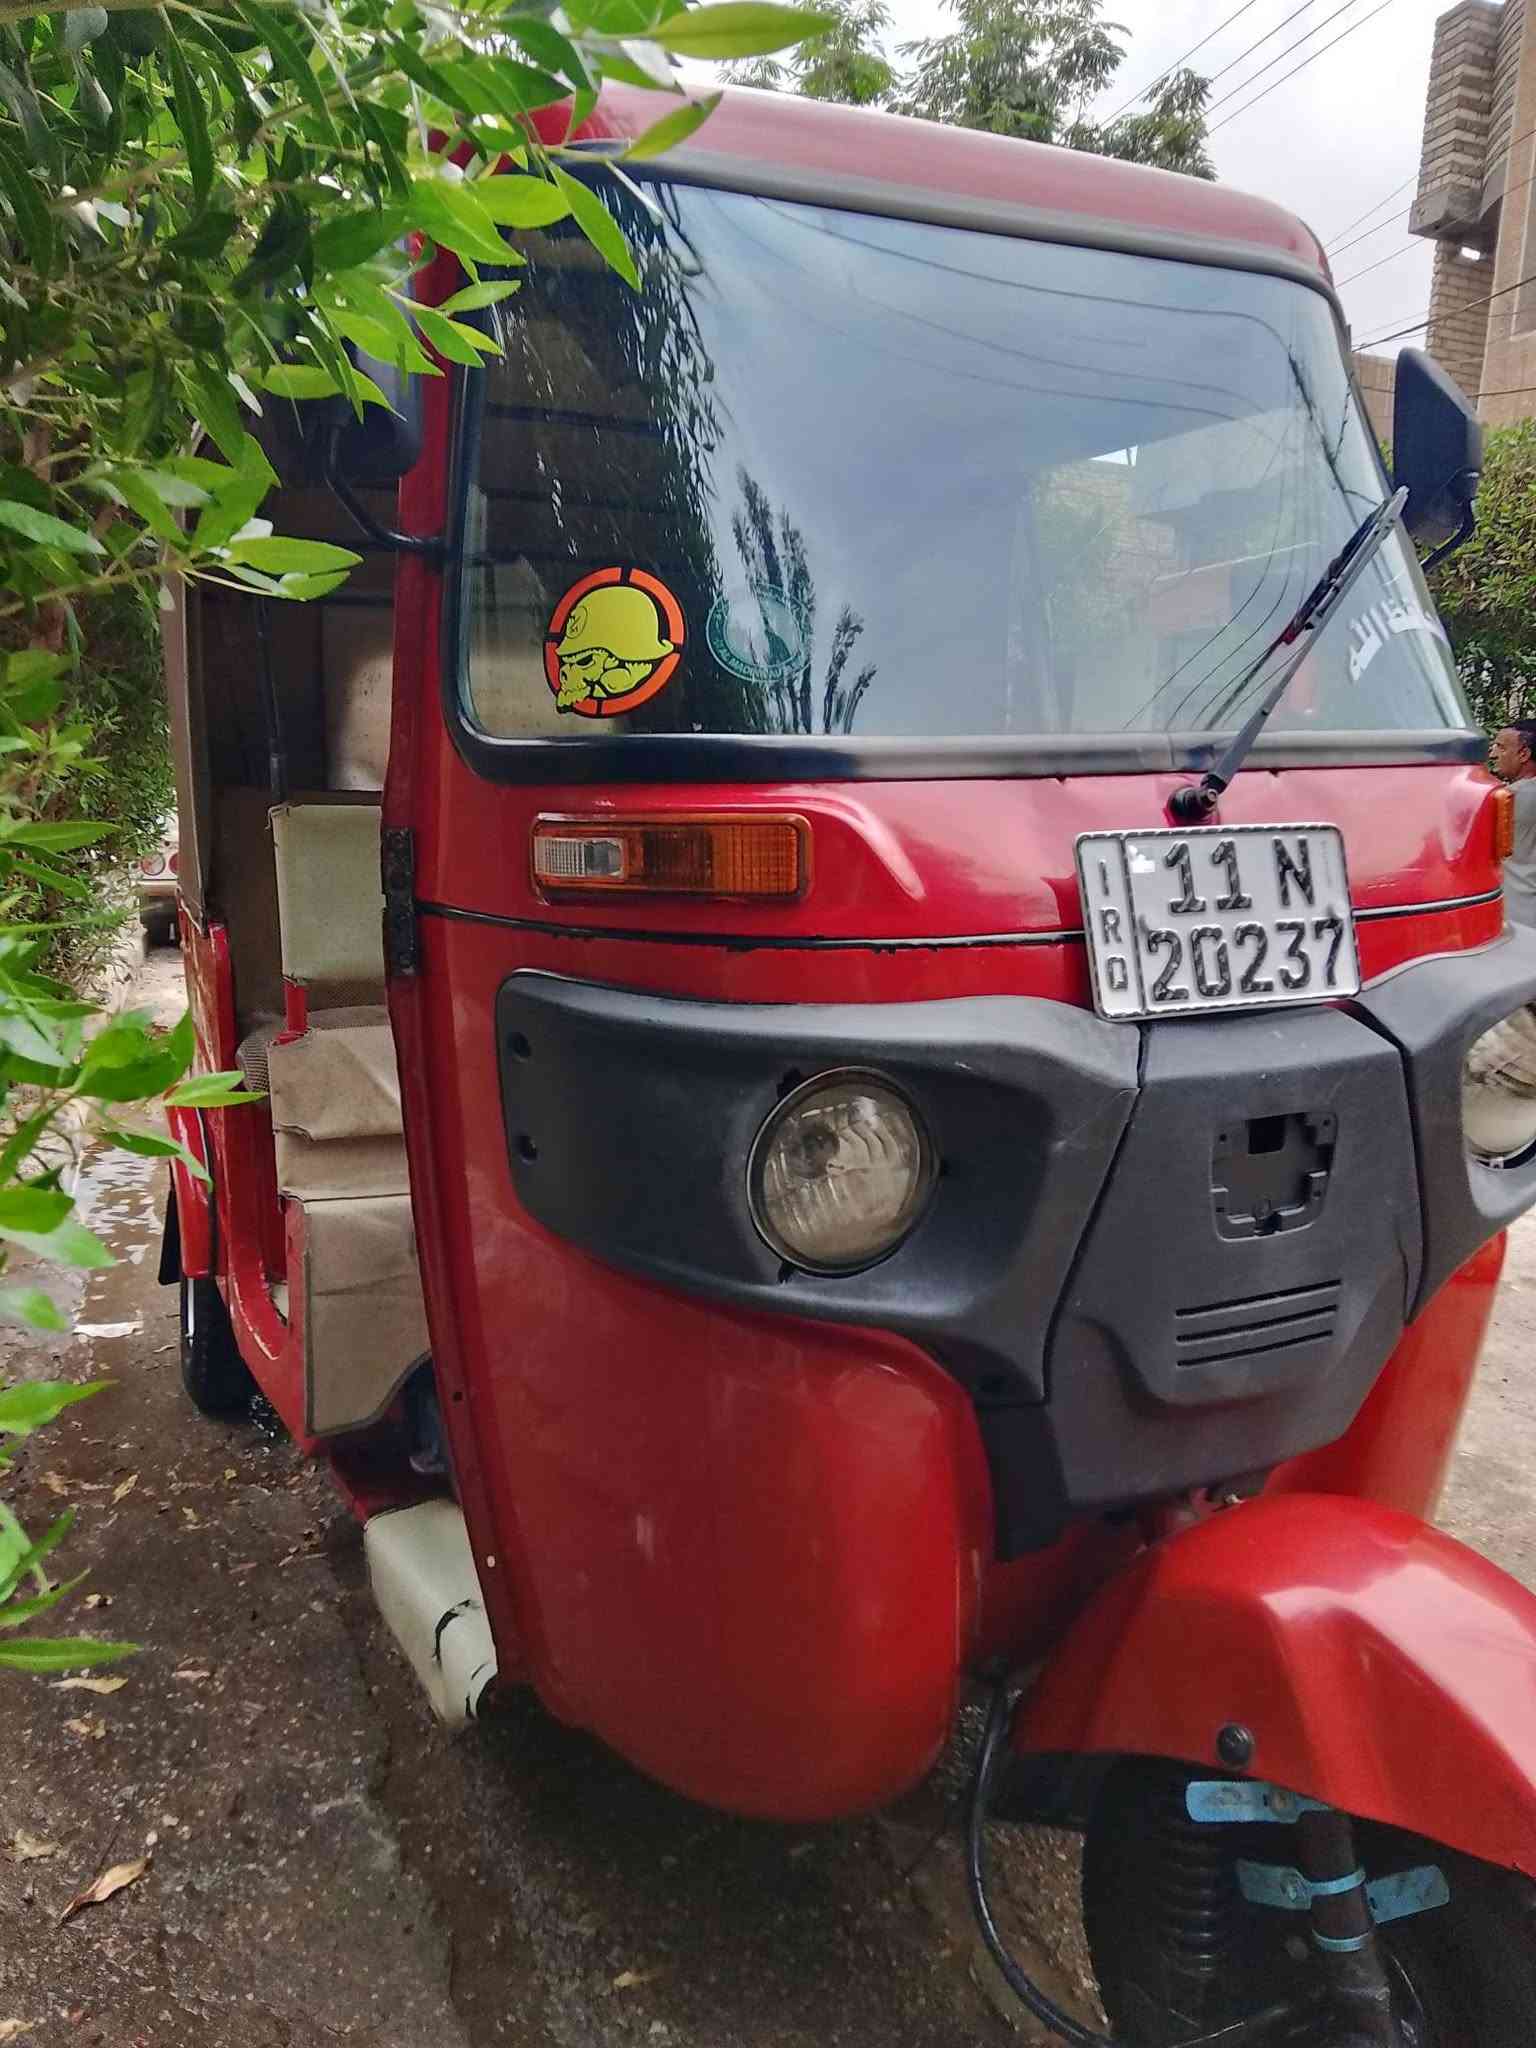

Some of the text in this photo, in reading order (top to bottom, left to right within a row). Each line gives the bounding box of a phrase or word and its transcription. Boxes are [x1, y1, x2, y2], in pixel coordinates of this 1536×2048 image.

[1164, 836, 1315, 913] 11 N
[1147, 916, 1344, 1001] 20237
